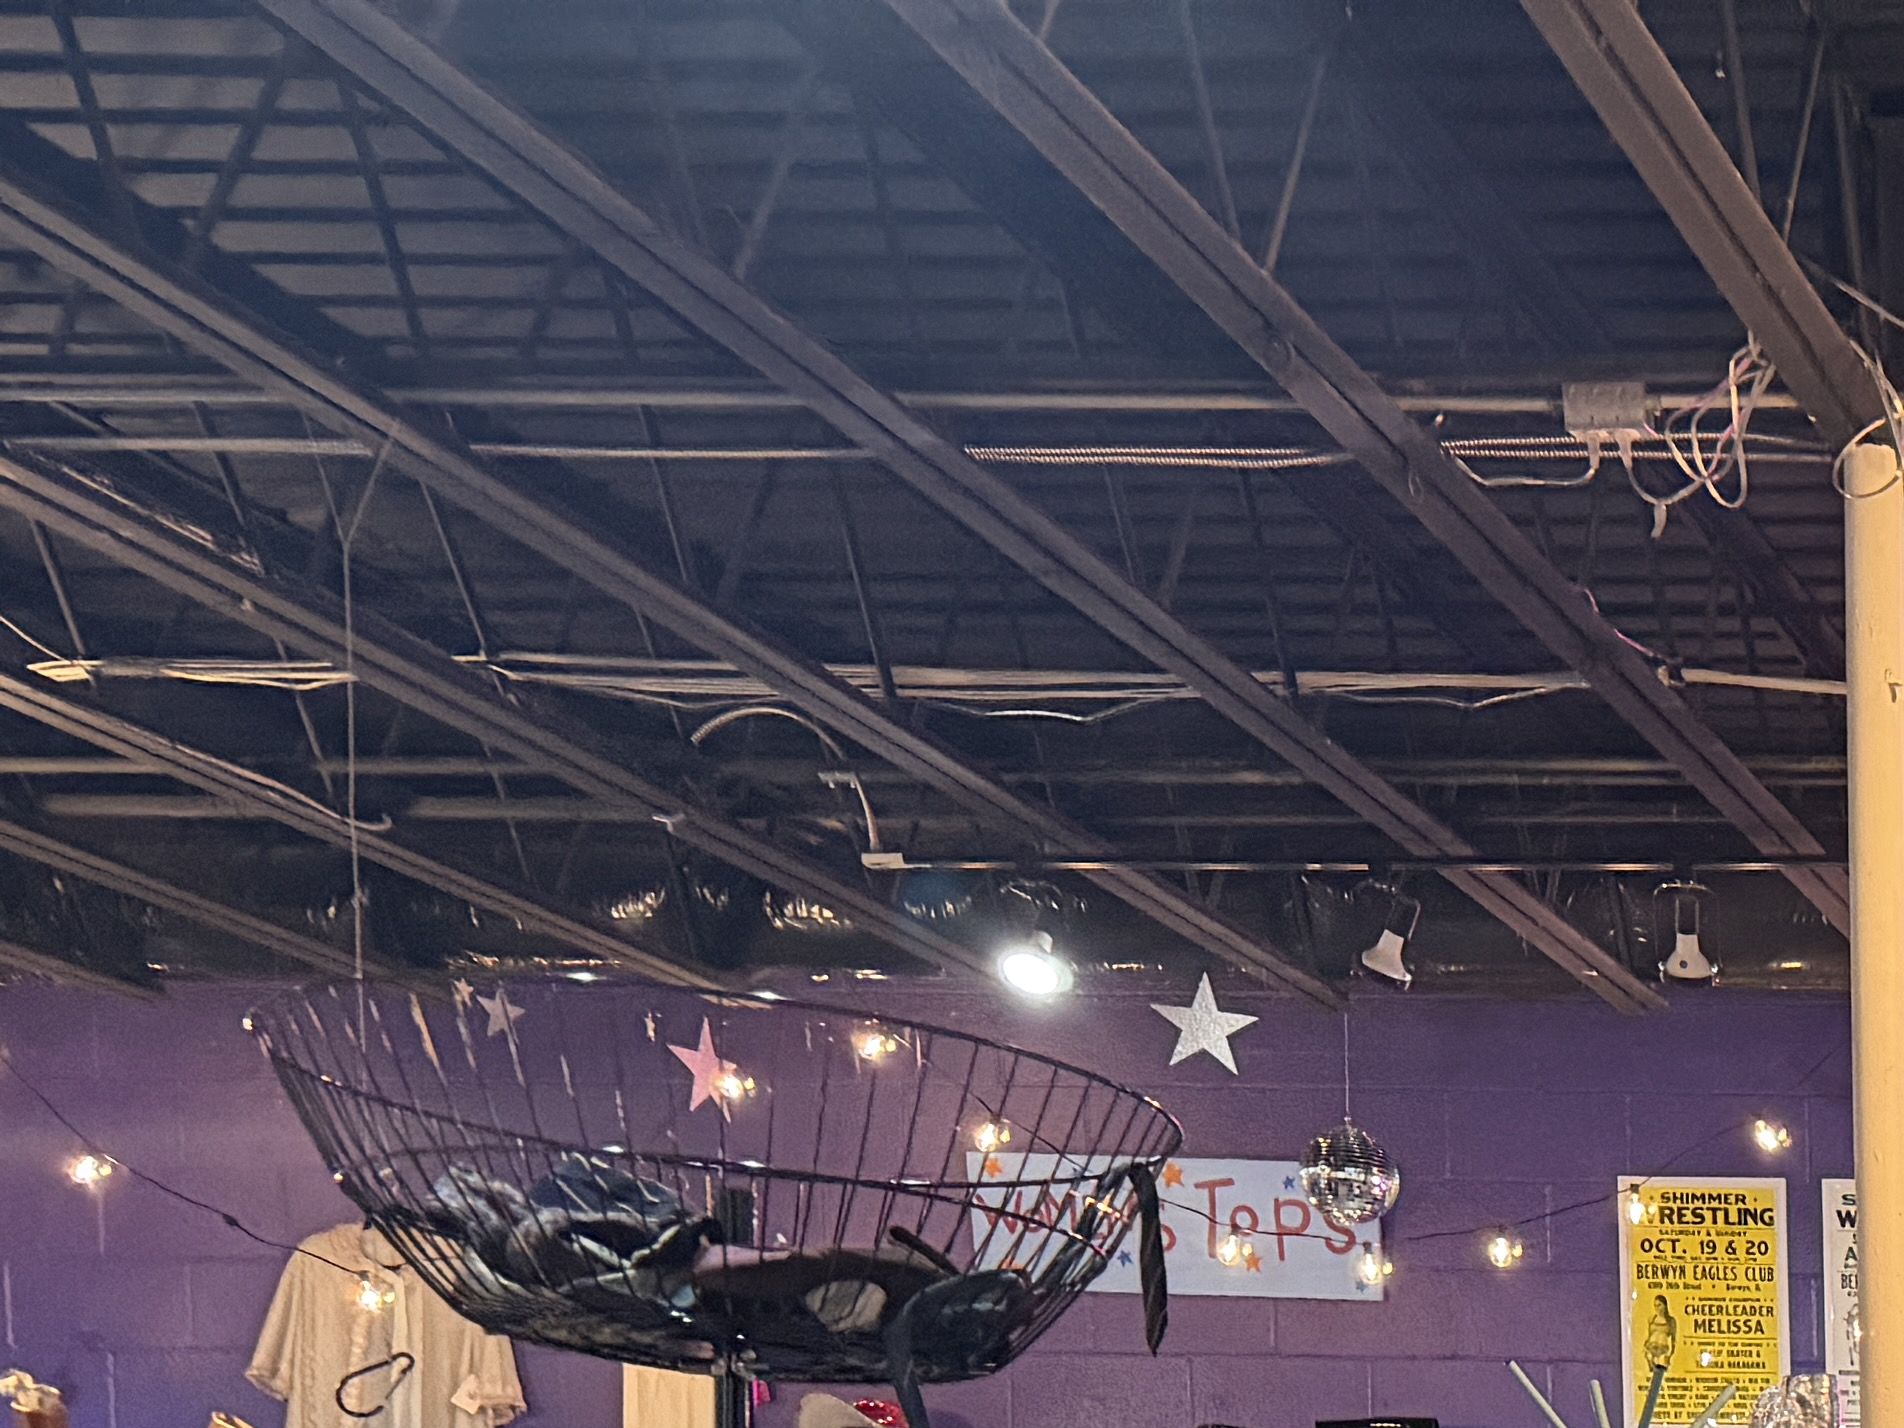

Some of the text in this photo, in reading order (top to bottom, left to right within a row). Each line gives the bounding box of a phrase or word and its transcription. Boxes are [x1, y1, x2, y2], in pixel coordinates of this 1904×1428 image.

[1660, 1191, 1747, 1206] SHIMMER
[1638, 1205, 1775, 1227] RESTLING
[1640, 1238, 1769, 1256] OCT. 19 & 20
[1636, 1264, 1775, 1282] BERWYN EAGLES CLUB
[1684, 1304, 1774, 1317] CHEERLEADER
[1693, 1318, 1765, 1335] MELISSA
